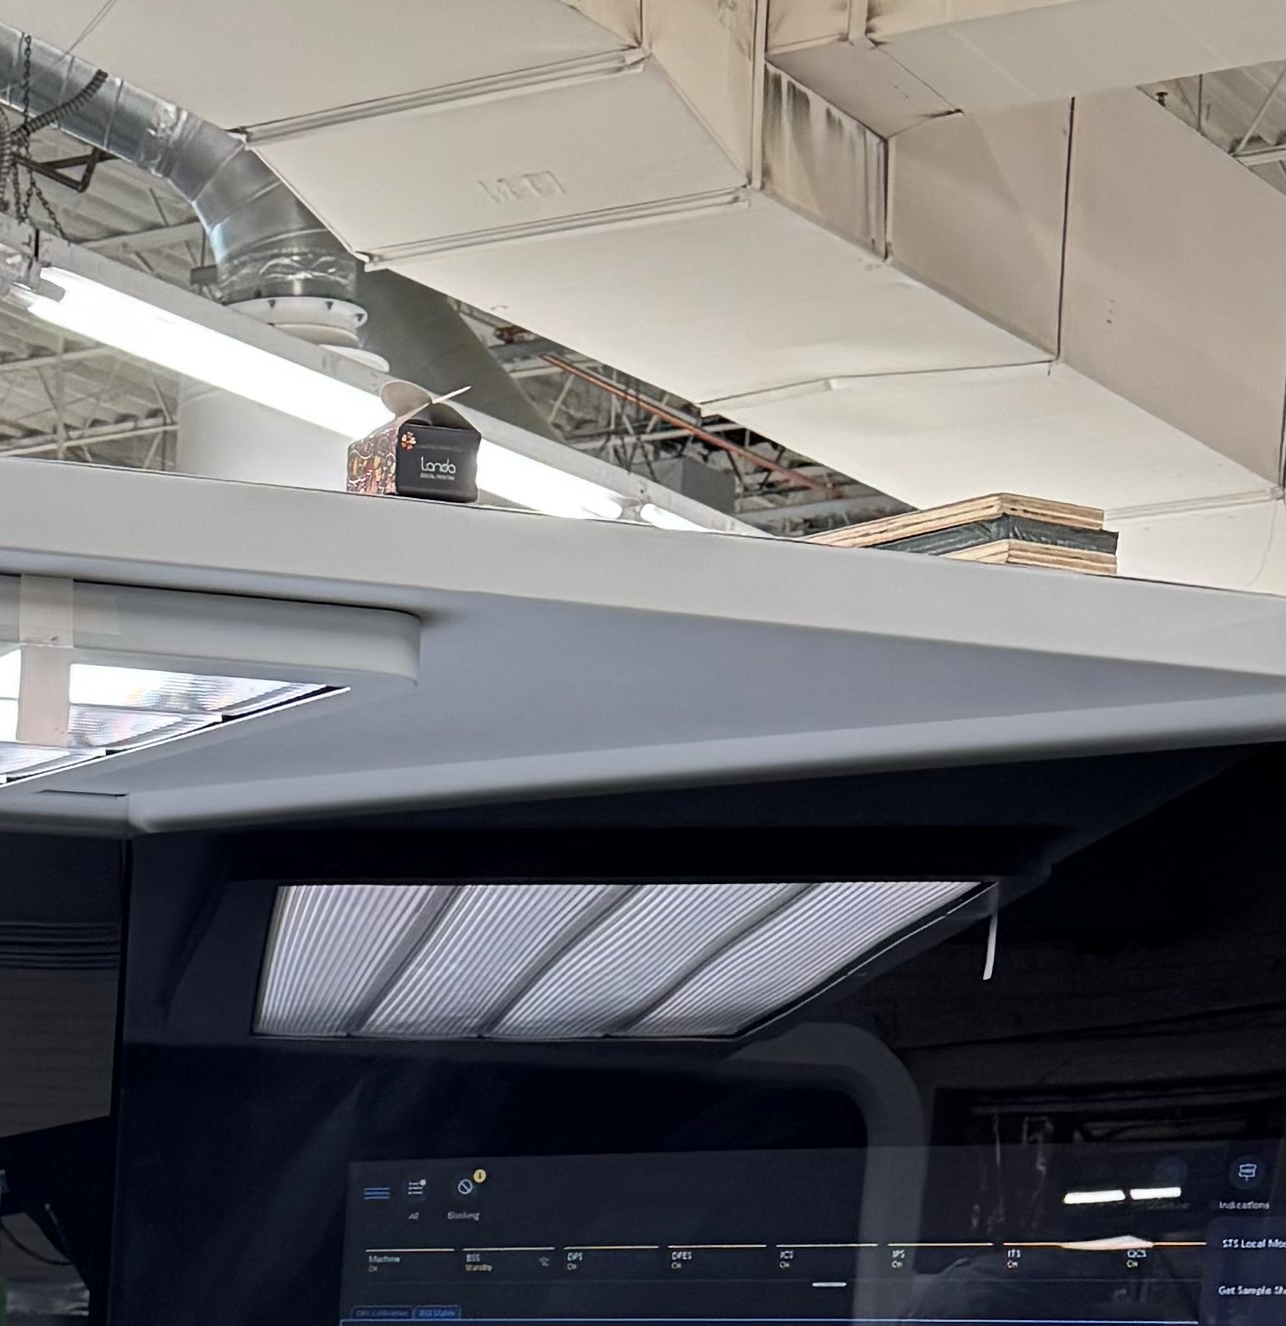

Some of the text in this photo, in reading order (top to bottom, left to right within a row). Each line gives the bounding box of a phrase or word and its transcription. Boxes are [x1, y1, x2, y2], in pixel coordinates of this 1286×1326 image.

[420, 456, 456, 474] Landa
[1241, 1239, 1266, 1248] Local
[1218, 1286, 1271, 1296] Get Sample
